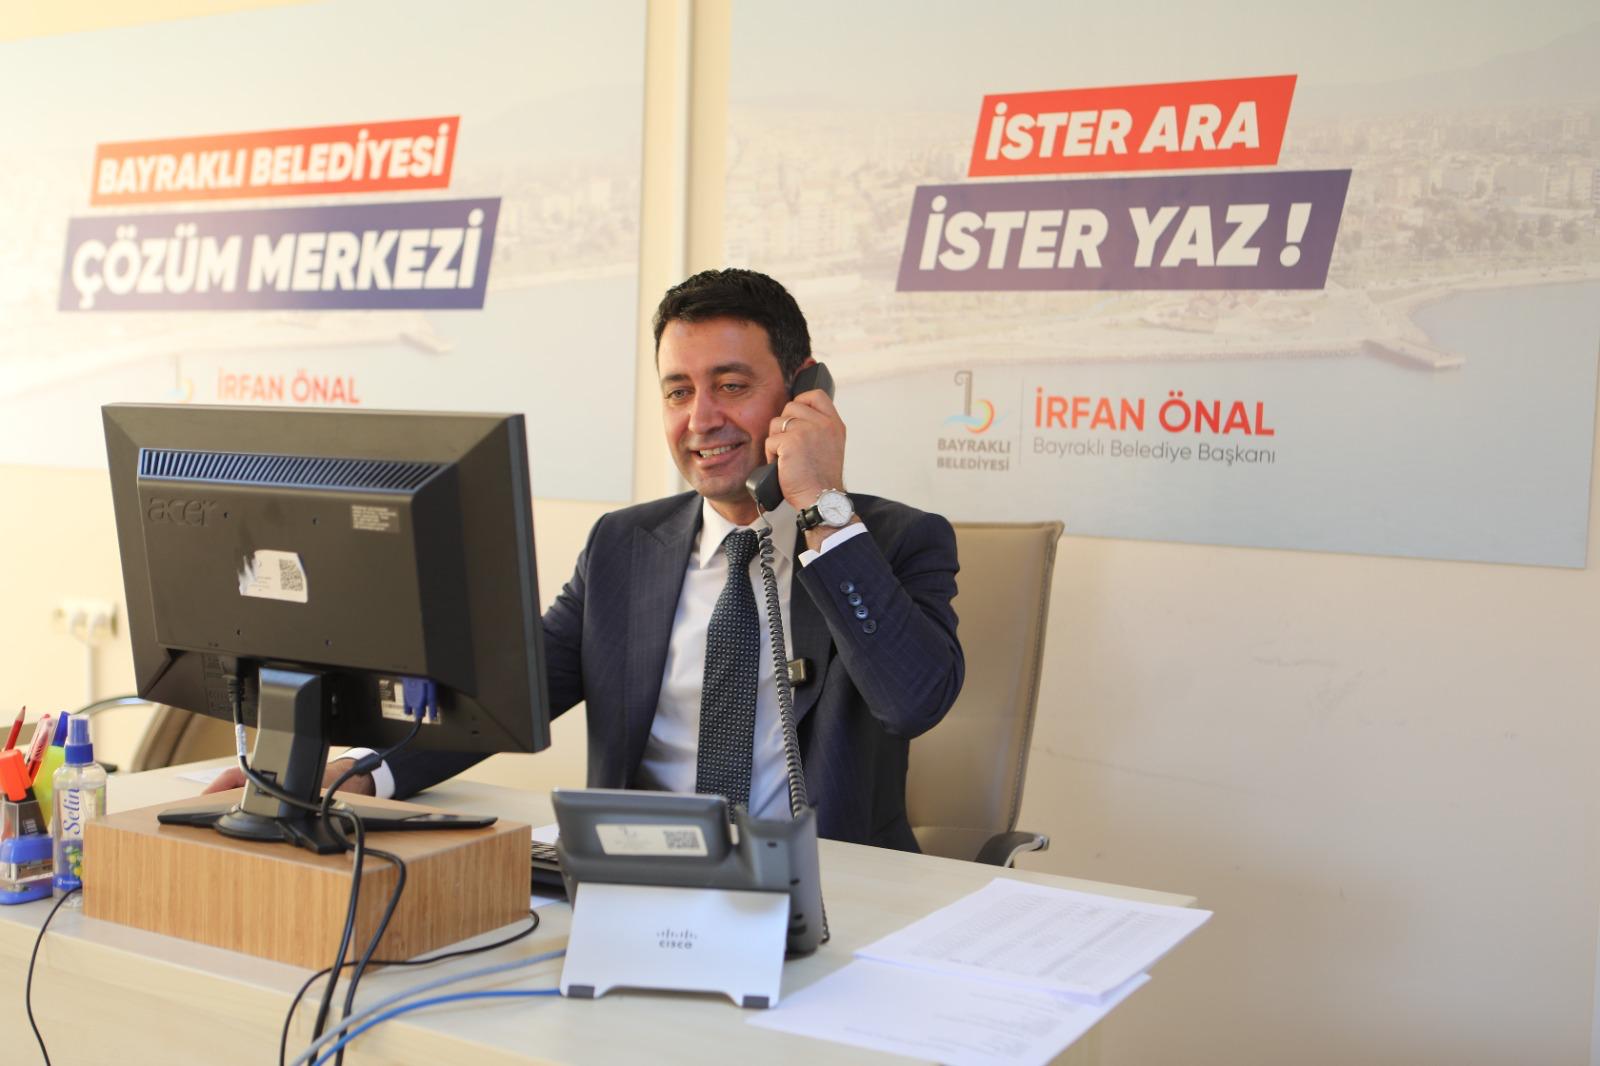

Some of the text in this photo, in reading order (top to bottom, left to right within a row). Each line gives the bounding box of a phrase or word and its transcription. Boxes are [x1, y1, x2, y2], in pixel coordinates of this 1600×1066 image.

[985, 101, 1260, 161] İSTER ARA
[98, 123, 451, 196] BAYRAKLI BELEDİYESİ
[918, 195, 1109, 271] İSTER
[1128, 204, 1270, 268] YAZ
[72, 208, 485, 309] ÇÖZÜM MERKEZİ
[217, 367, 360, 404] İRFAN ÖNAL
[1035, 386, 1275, 436] İRFAN ÖNAL
[937, 438, 1011, 454] BAYRAKLI
[937, 456, 1010, 472] BELEDİYESİ
[1033, 437, 1276, 466] Bayraklı Belediye Başkanı
[147, 496, 217, 527] acer
